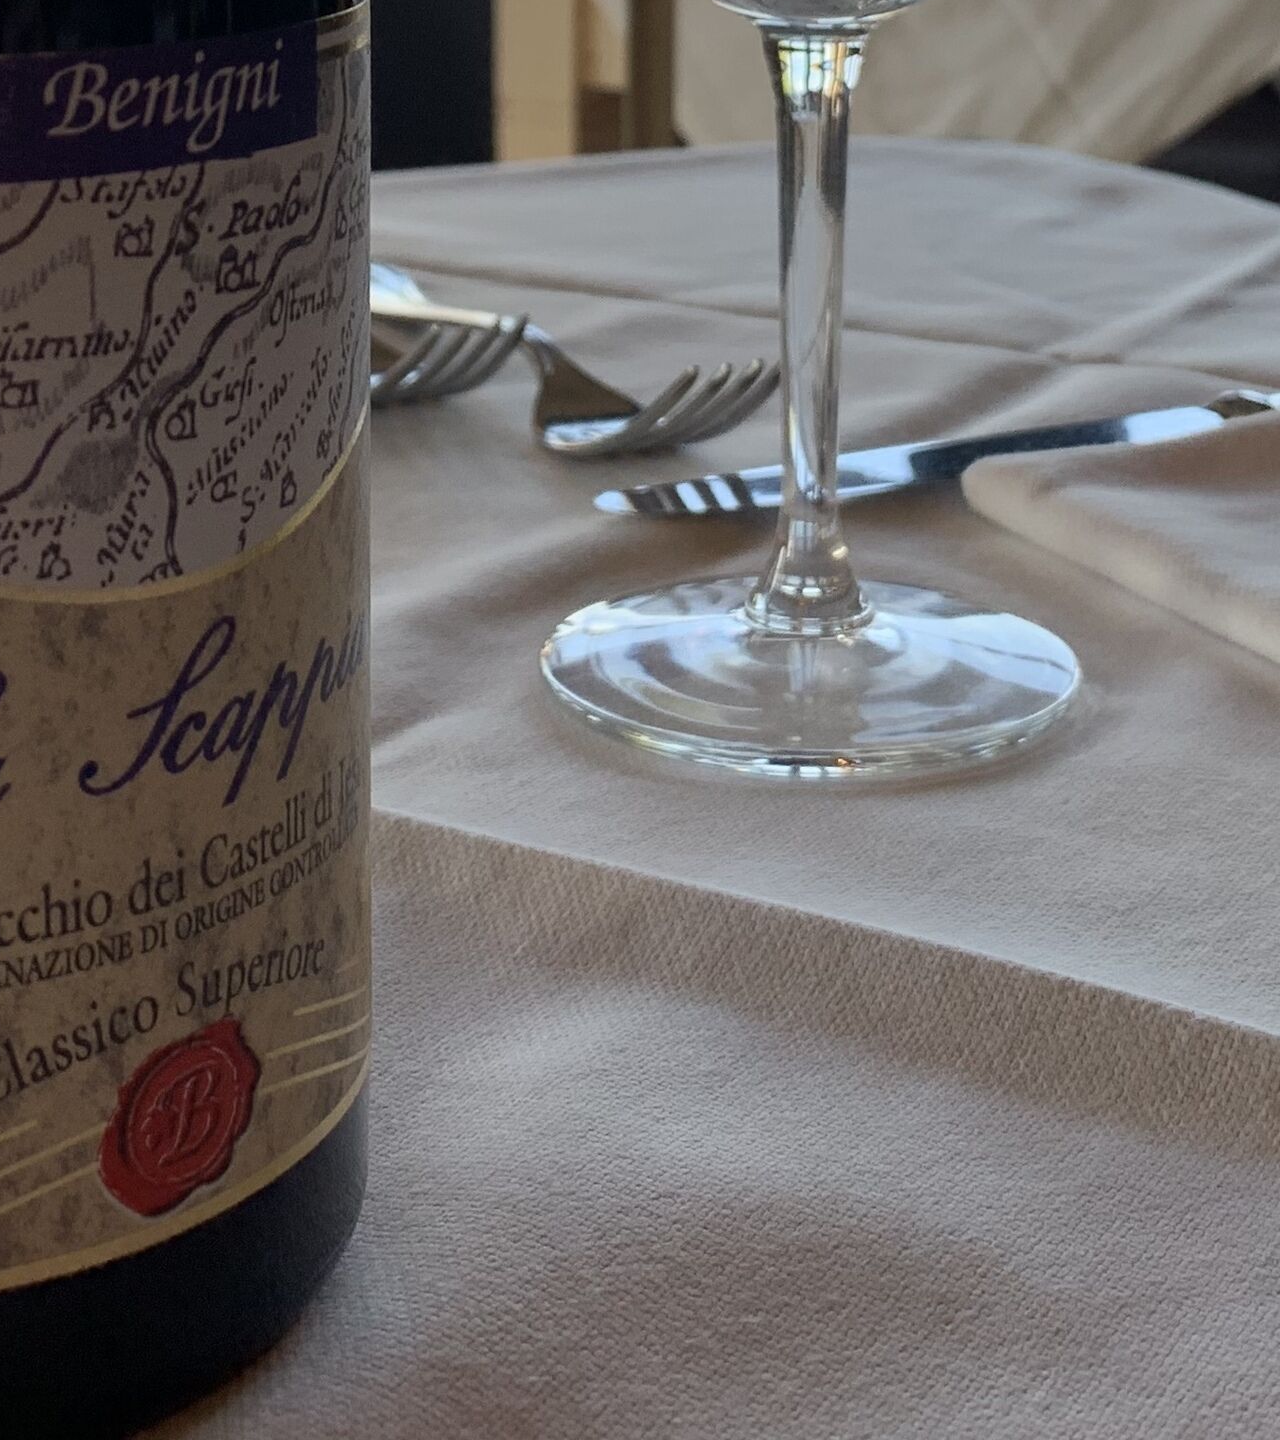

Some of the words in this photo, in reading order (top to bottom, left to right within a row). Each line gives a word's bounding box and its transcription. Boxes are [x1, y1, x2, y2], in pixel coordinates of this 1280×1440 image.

[42, 37, 282, 153] Benigni
[127, 848, 188, 916] dei
[199, 791, 307, 889] Castelli
[313, 770, 333, 831] di
[139, 919, 169, 955] DI
[174, 877, 267, 941] ORIGINE
[175, 927, 326, 1017] Superiore
